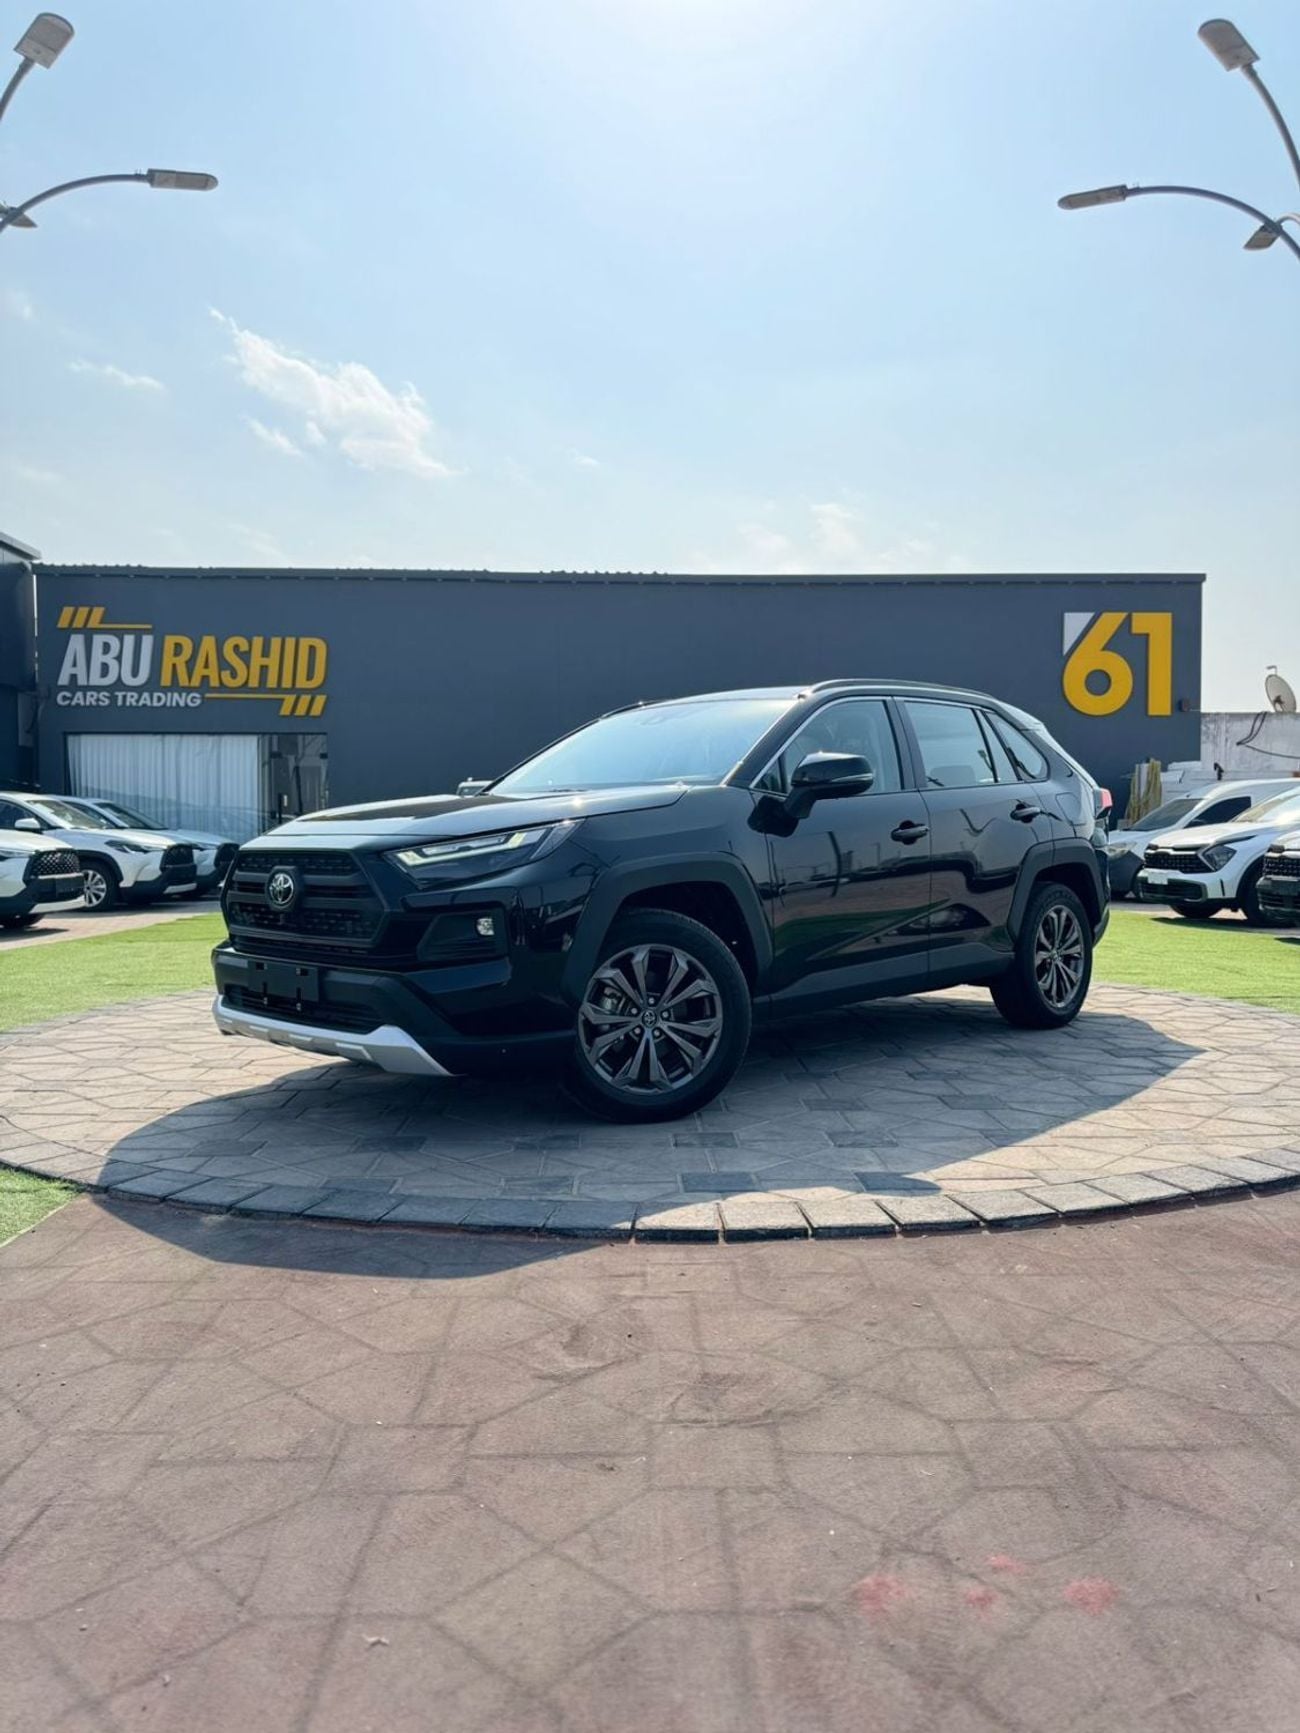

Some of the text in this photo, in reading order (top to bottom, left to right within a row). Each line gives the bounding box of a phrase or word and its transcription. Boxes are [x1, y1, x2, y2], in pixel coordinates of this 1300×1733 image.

[57, 634, 328, 688] ABU RASHID
[1063, 612, 1172, 715] 61
[56, 691, 201, 707] CARS TRADING
